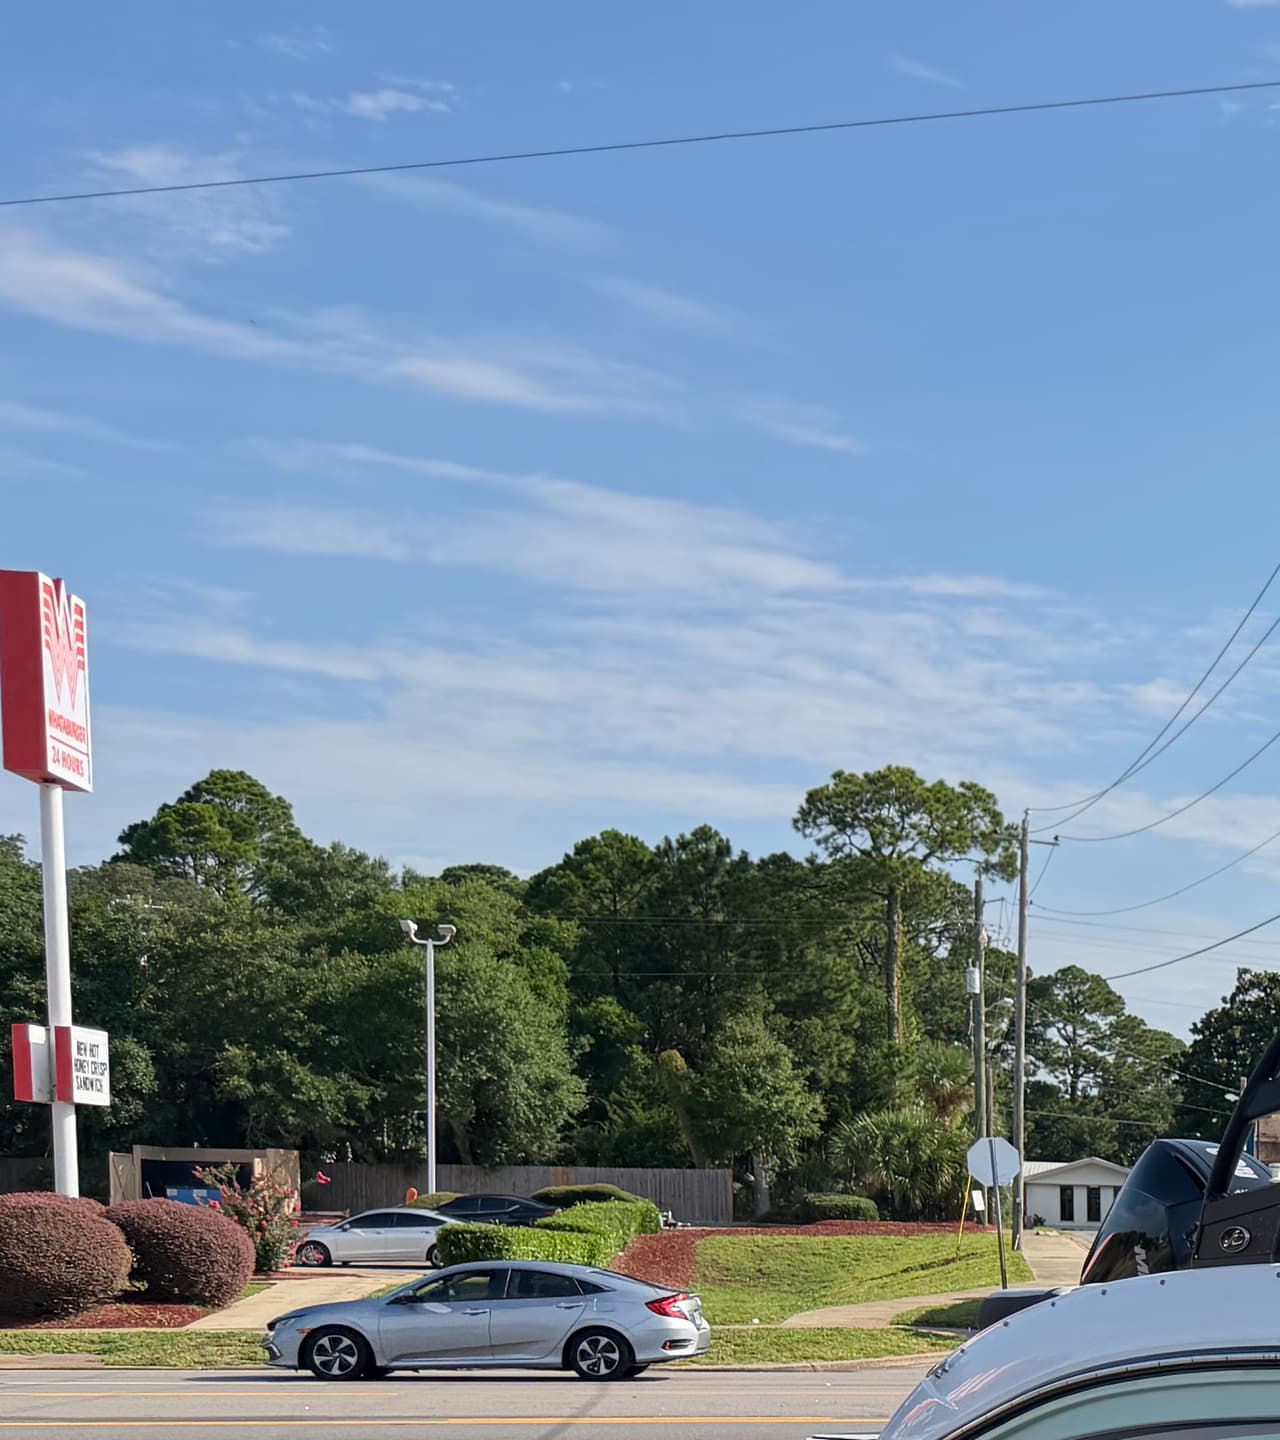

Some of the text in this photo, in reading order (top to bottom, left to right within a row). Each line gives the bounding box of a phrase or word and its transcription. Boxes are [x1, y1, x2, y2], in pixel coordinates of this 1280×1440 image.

[49, 708, 86, 744] WHATABURGER
[52, 745, 84, 777] 24 HOURS
[77, 1040, 99, 1059] NEW HOT
